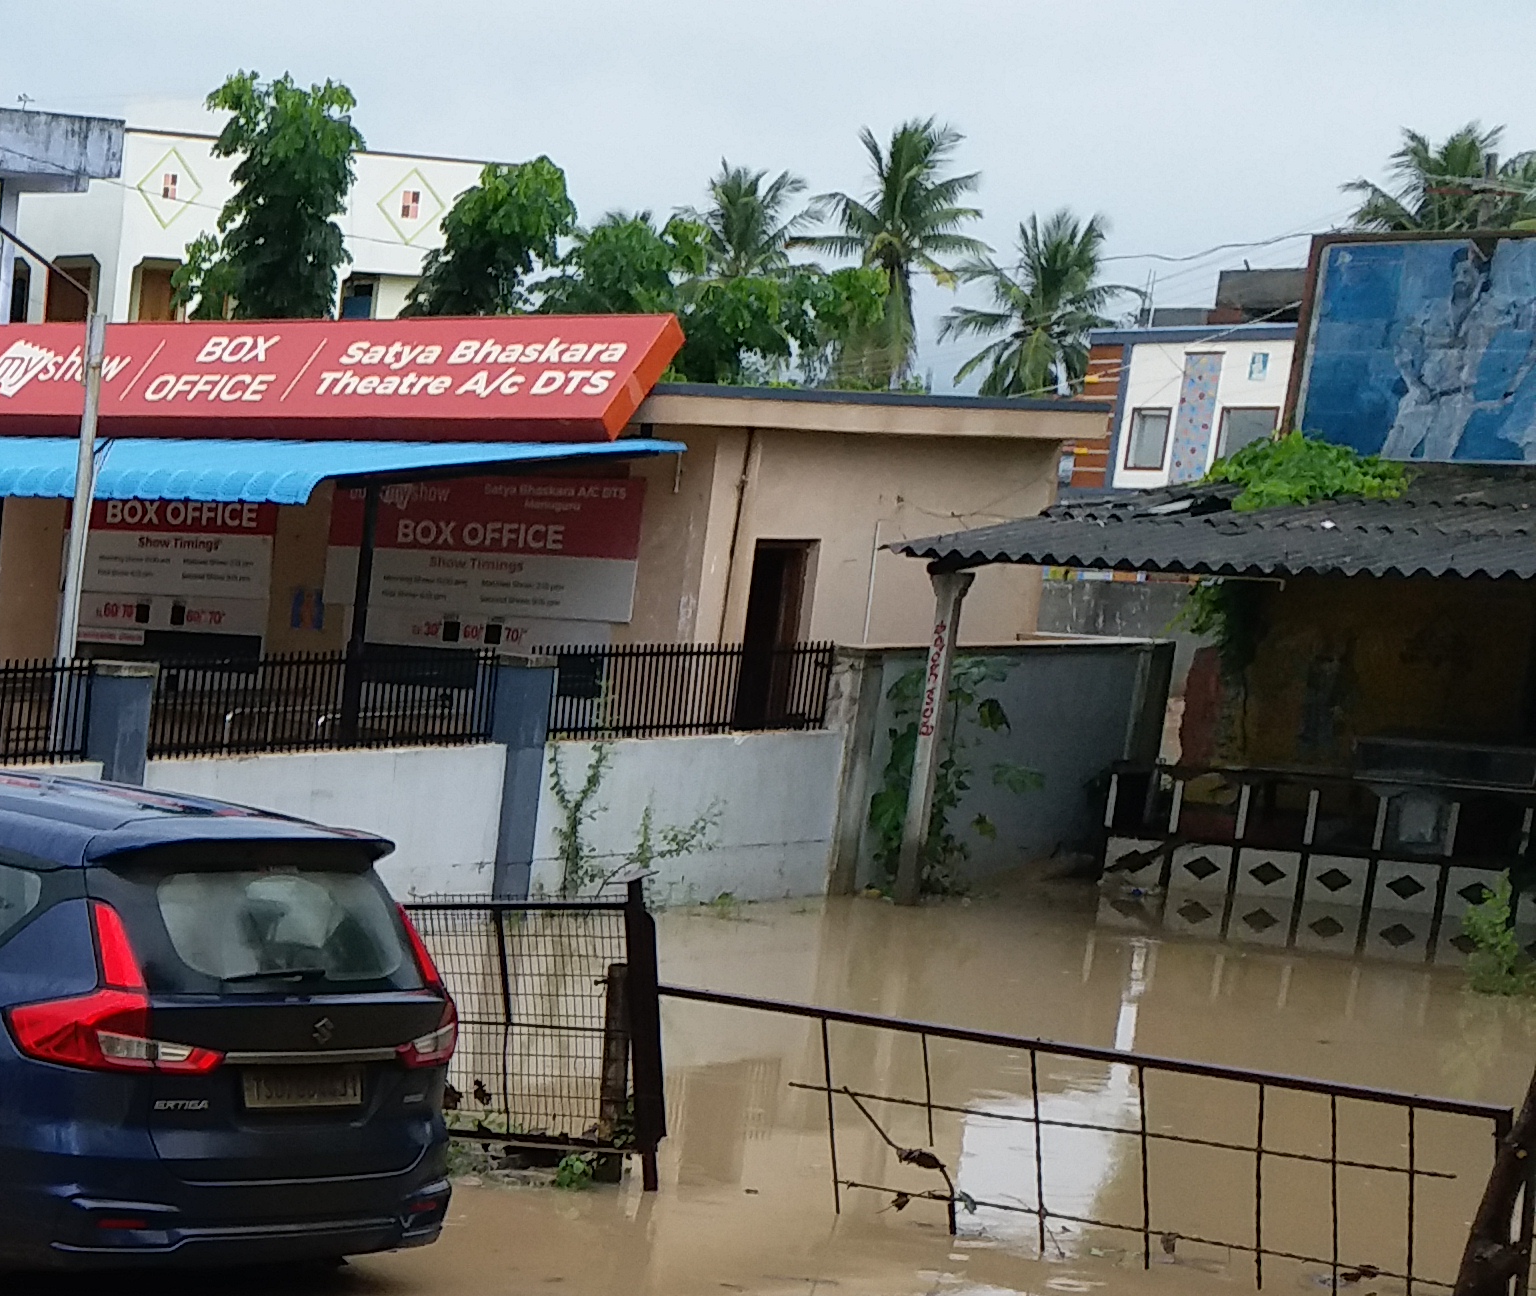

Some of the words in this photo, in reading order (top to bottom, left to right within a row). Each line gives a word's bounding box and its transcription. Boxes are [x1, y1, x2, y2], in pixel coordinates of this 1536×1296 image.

[197, 335, 281, 364] BOX
[339, 341, 443, 370] Satya
[446, 340, 628, 364] Bhaskara
[144, 374, 277, 402] OFFICE
[315, 370, 453, 397] Theatre
[454, 367, 526, 399] A/c
[529, 370, 617, 396] DTS
[484, 484, 516, 498] Satya
[519, 485, 575, 498] Bhaskara
[106, 500, 160, 525] BOX
[166, 502, 259, 529] OFFICE
[137, 536, 170, 550] Show
[173, 538, 224, 553] Timings
[397, 518, 455, 545] BOX
[462, 521, 565, 550] OFFICE
[429, 555, 466, 569] Show
[469, 557, 524, 574] Timings
[153, 1099, 209, 1111] ERTIGA
